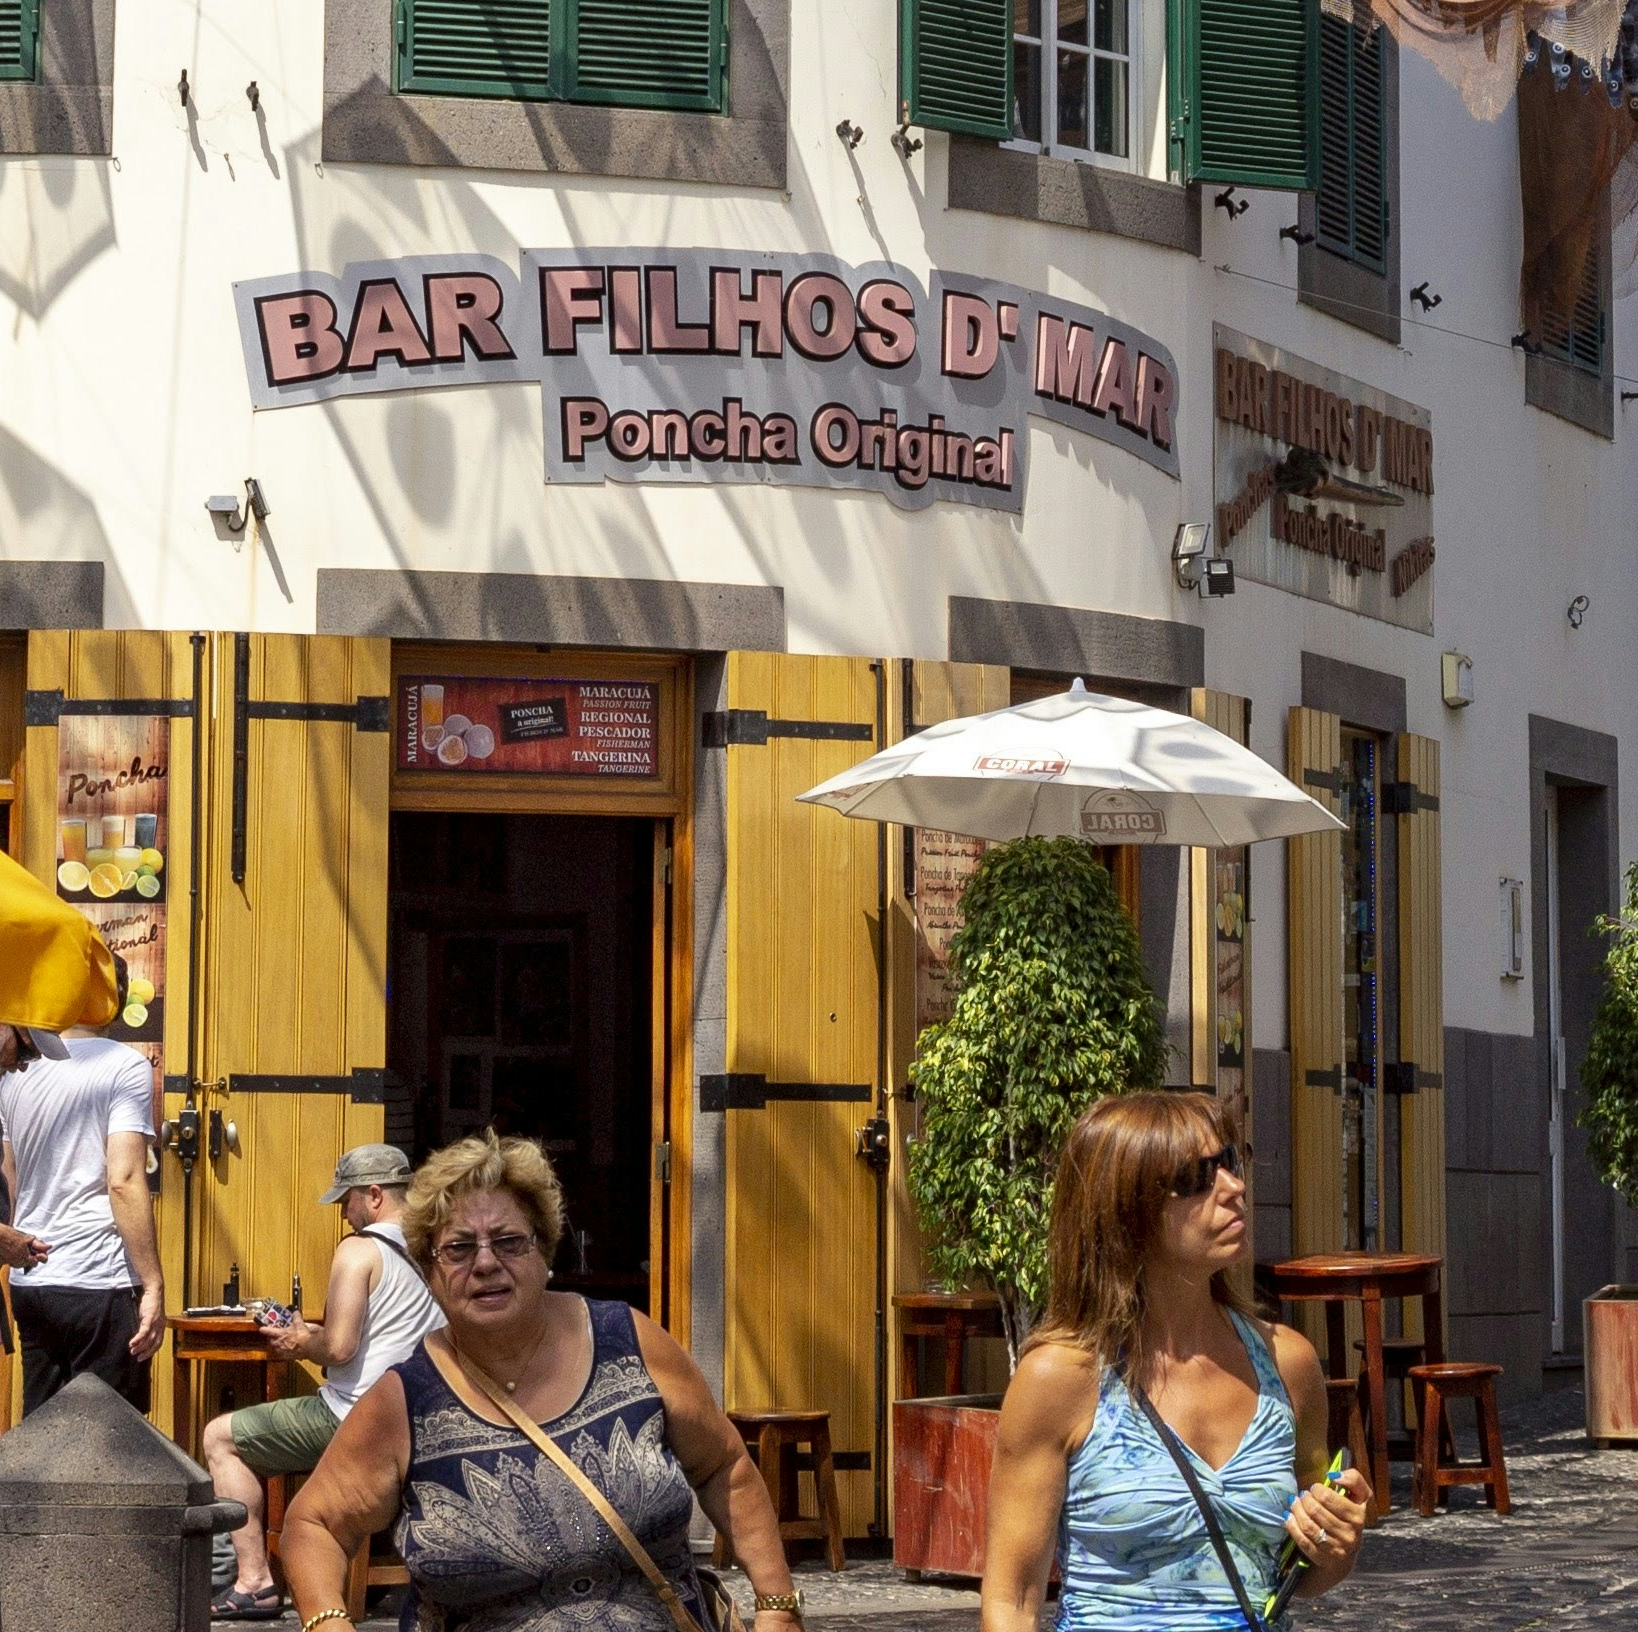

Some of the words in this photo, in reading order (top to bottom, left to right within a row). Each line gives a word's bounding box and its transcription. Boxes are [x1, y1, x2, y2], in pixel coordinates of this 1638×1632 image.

[254, 271, 517, 388] BAR
[540, 264, 918, 368] FILHOS
[940, 288, 1020, 380] D'
[1032, 304, 1180, 454] MAR
[1216, 349, 1269, 435] BAR
[1269, 369, 1355, 468] FILHOS
[1381, 414, 1435, 495] MAR
[560, 396, 801, 466] Poncha
[809, 403, 1016, 492] Original
[1270, 492, 1330, 554] Poncha
[1327, 511, 1386, 577] Original
[579, 685, 651, 700] MARACUJÁ
[582, 699, 622, 708] PASSION
[623, 700, 652, 710] FRUIT
[510, 705, 554, 719] PONCHA
[580, 711, 652, 724] REGIONAL
[407, 685, 418, 763] MARACUJÁ
[578, 726, 651, 739] PESCADOR
[596, 739, 651, 749] FISHERMAN
[571, 750, 651, 764] TANGERINA
[597, 764, 651, 774] TANGERINE
[985, 758, 1059, 772] CORAL
[67, 755, 169, 805] Poncha
